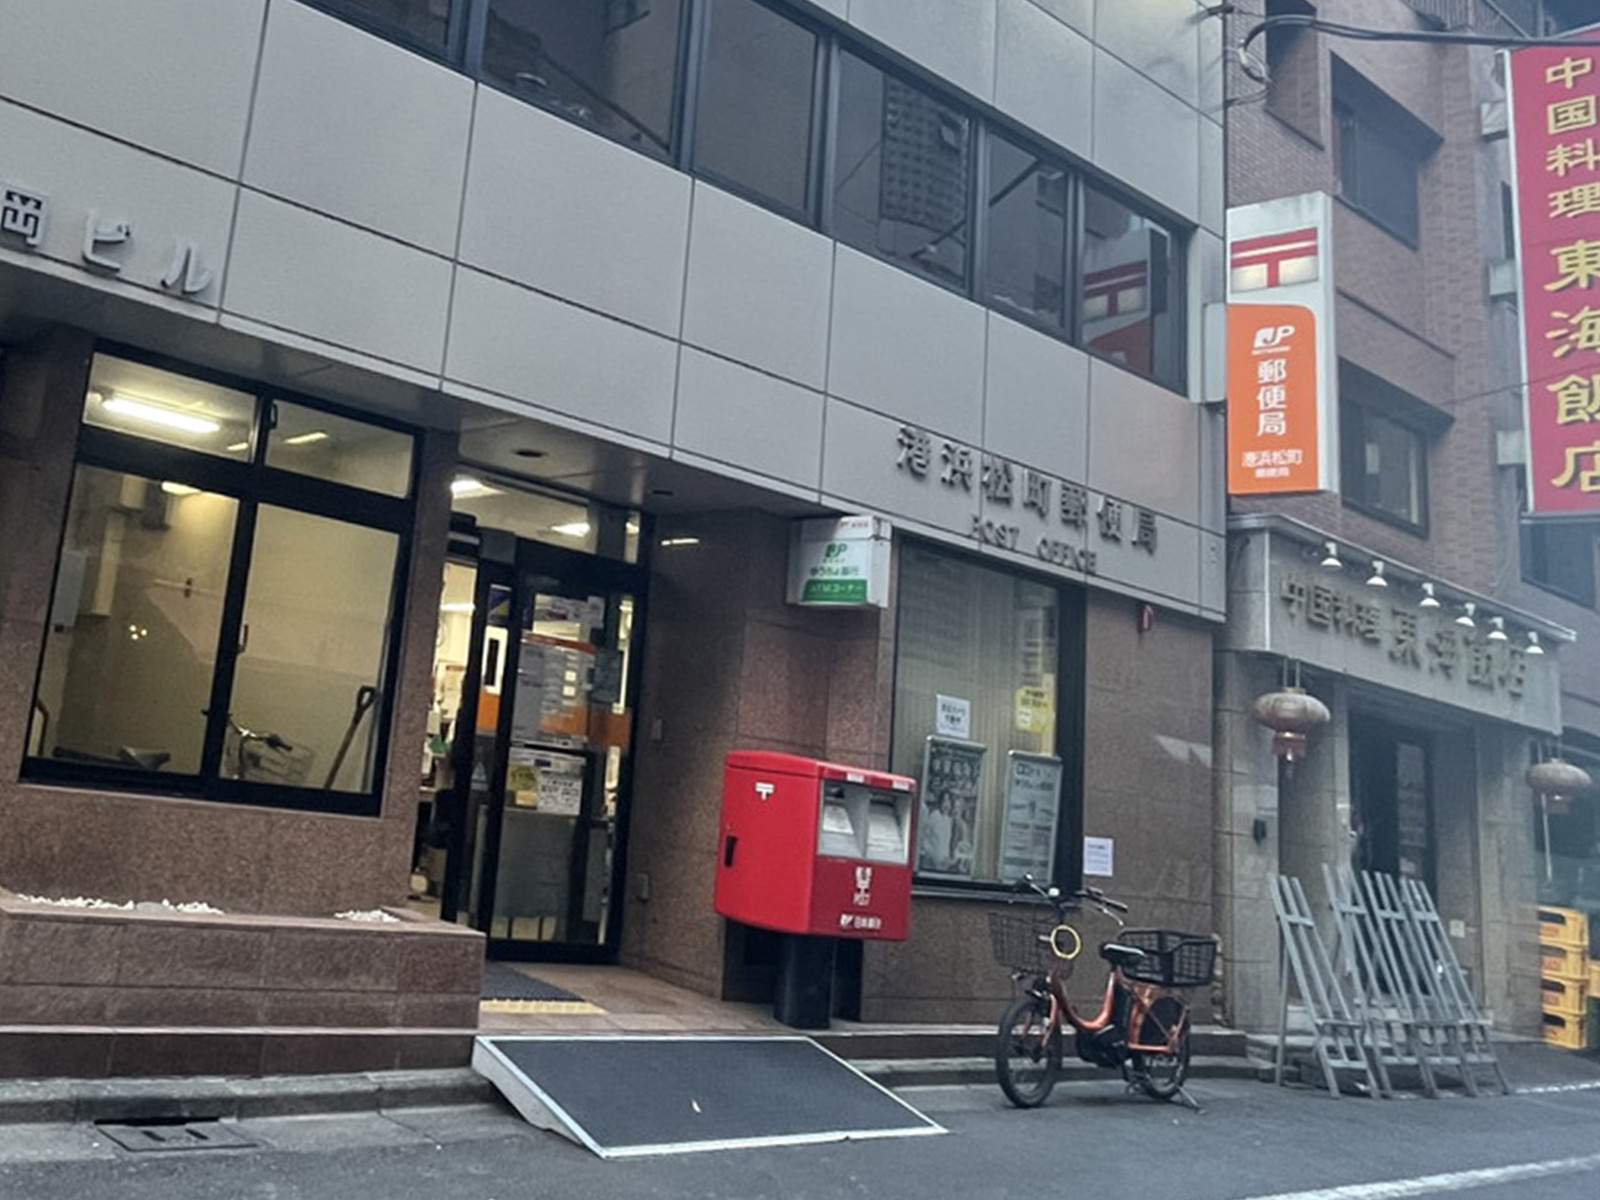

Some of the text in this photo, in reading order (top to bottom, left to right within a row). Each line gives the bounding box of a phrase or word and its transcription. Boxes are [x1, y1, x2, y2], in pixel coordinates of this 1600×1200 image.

[1545, 56, 1600, 218] 中国料理
[0, 184, 214, 295] 岡ビル
[1256, 359, 1287, 438] 郵便局
[1543, 238, 1600, 493] 東海飯店
[897, 424, 1159, 556] 港浜松町郵便局
[969, 514, 1021, 551] POST
